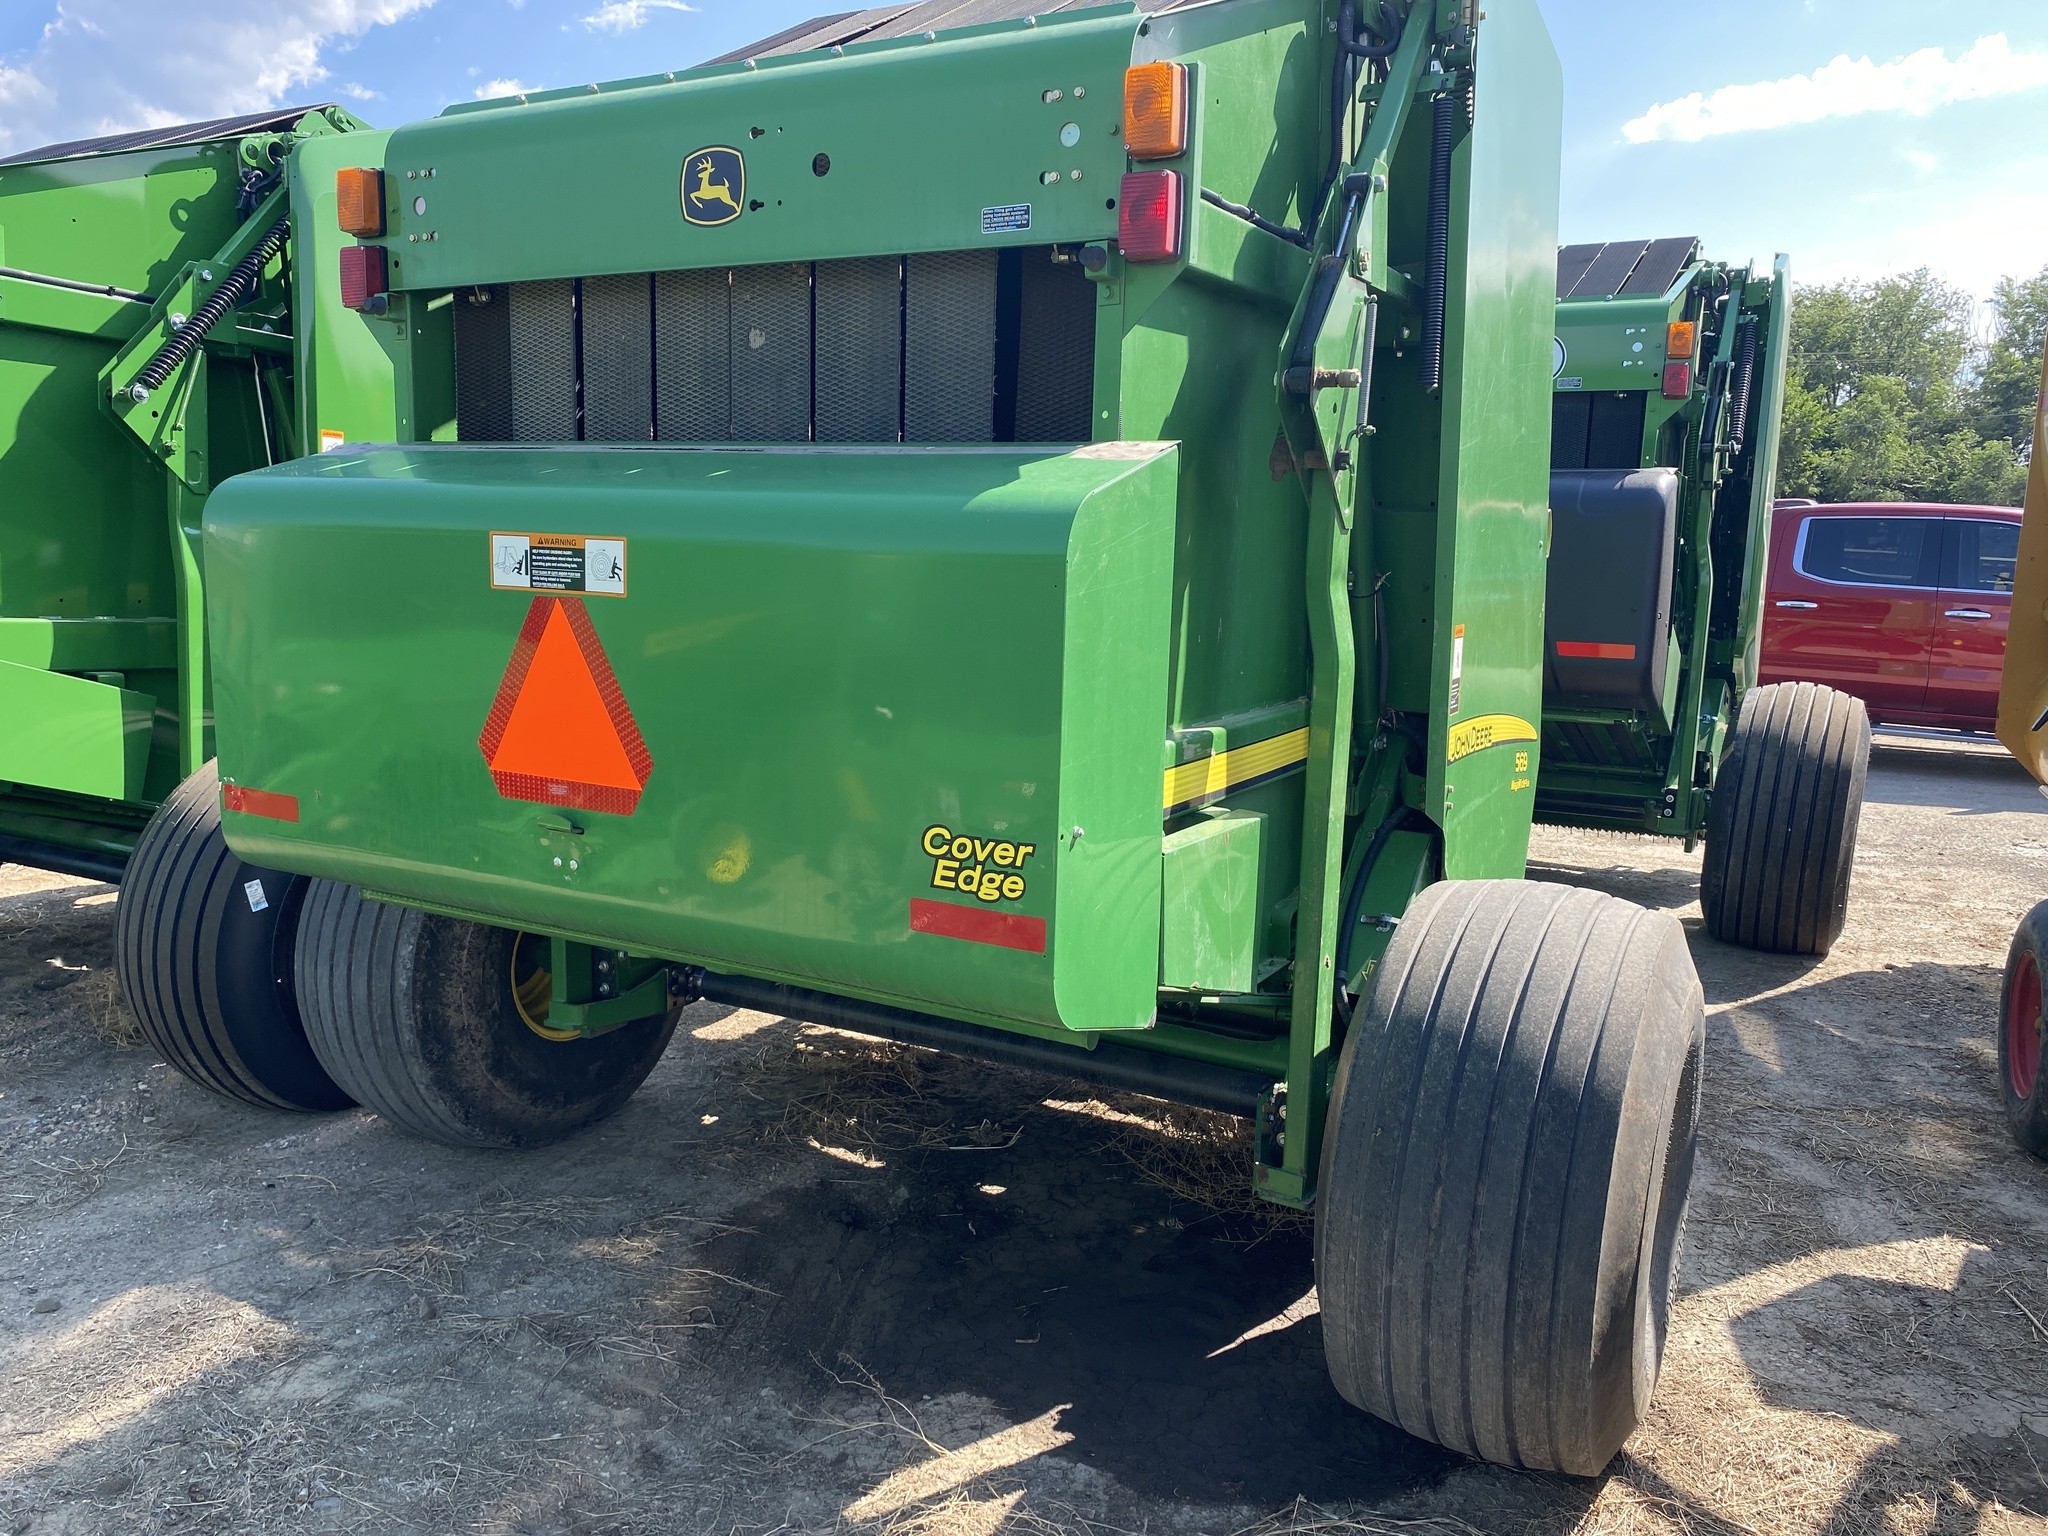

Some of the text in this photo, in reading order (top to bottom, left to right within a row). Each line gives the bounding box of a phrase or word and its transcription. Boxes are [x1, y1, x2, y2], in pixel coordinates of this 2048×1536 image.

[544, 538, 577, 546] WARNING
[1515, 751, 1528, 773] 569
[922, 825, 1035, 869] Cover
[932, 858, 1025, 902] Edge
